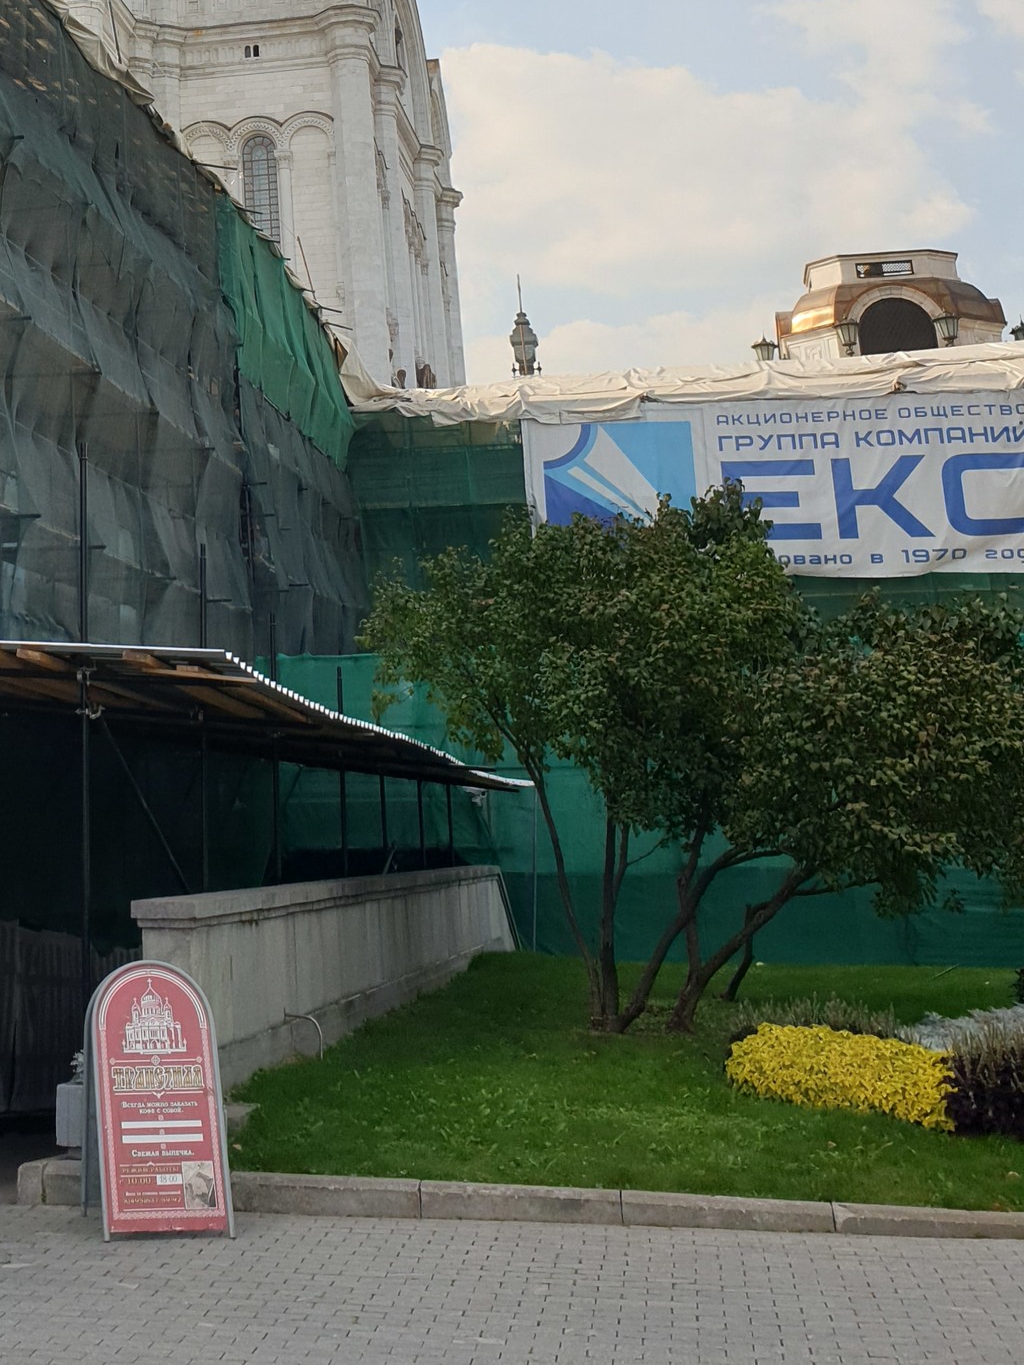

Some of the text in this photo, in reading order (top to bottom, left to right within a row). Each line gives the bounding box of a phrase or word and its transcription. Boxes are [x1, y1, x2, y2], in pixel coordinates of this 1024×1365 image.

[716, 408, 888, 426] АКЦИОНЕРНОЕ
[717, 432, 840, 451] ГРУППА
[901, 548, 968, 564] 1970
